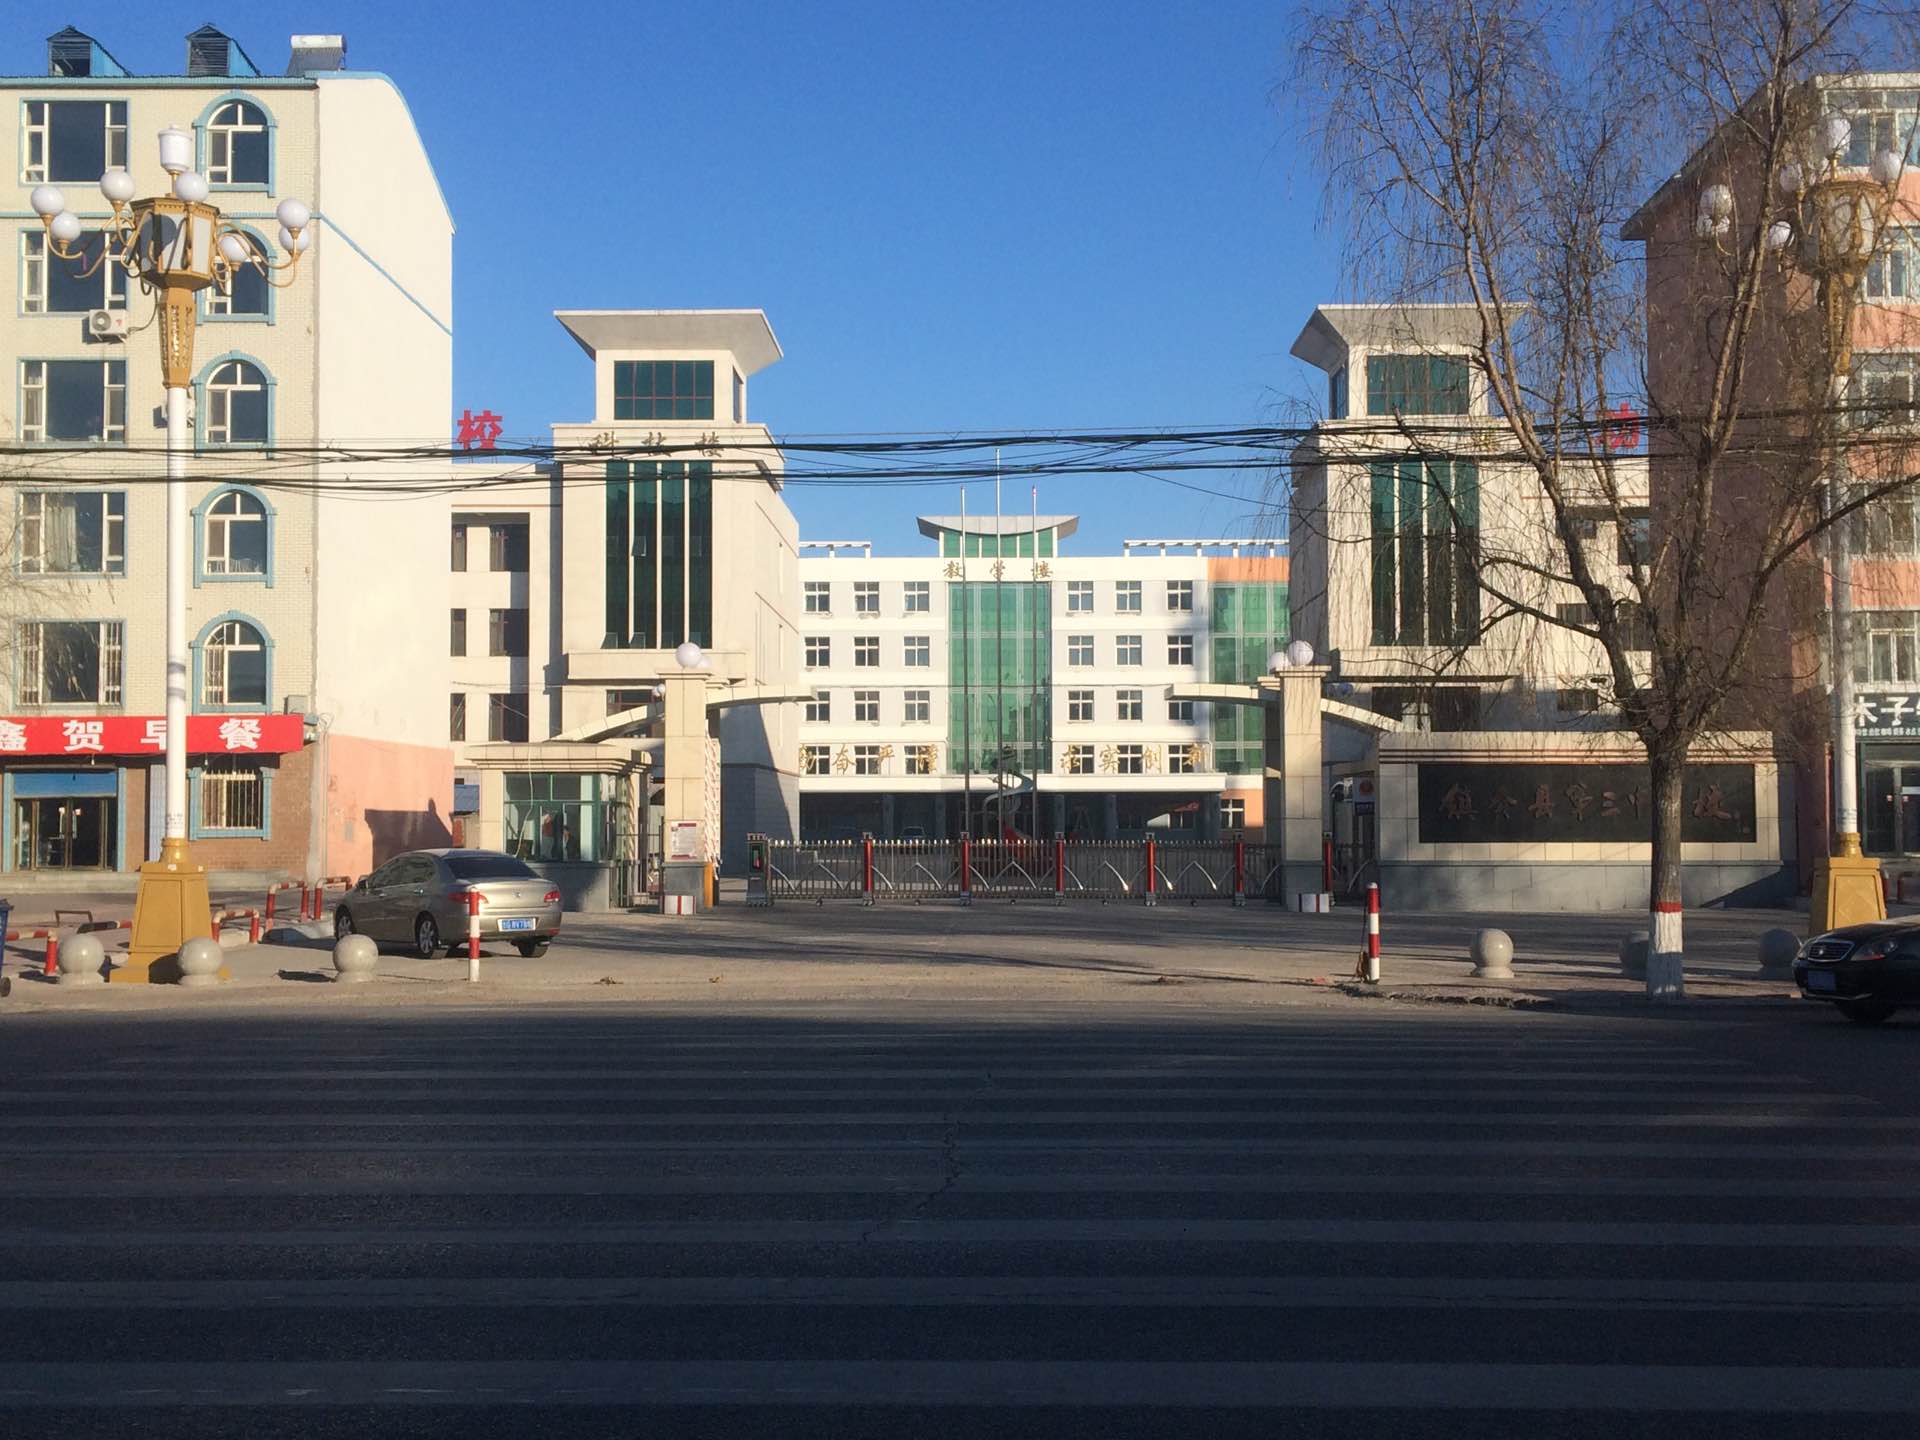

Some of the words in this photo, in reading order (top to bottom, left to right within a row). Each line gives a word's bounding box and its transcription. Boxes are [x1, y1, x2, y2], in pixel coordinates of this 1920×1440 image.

[457, 409, 503, 451] 校
[943, 559, 1054, 580] 教学楼
[1854, 695, 1920, 728] 木子
